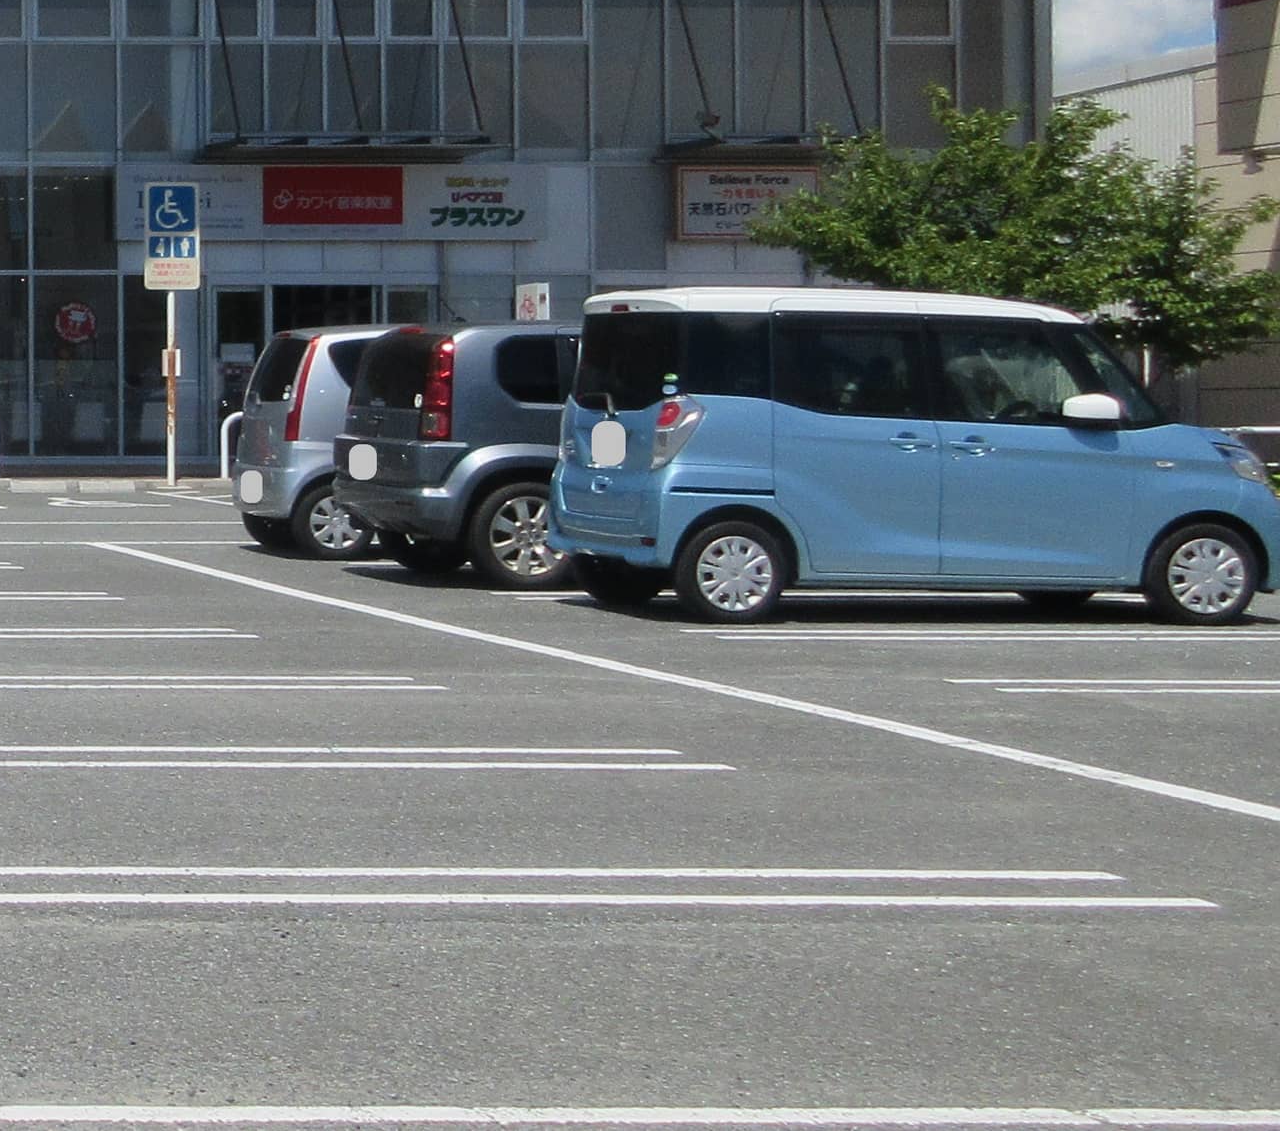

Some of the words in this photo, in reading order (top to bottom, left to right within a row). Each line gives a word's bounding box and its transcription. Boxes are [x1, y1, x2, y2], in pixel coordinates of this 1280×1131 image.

[755, 174, 790, 185] Force
[430, 206, 526, 227] プラスワン
